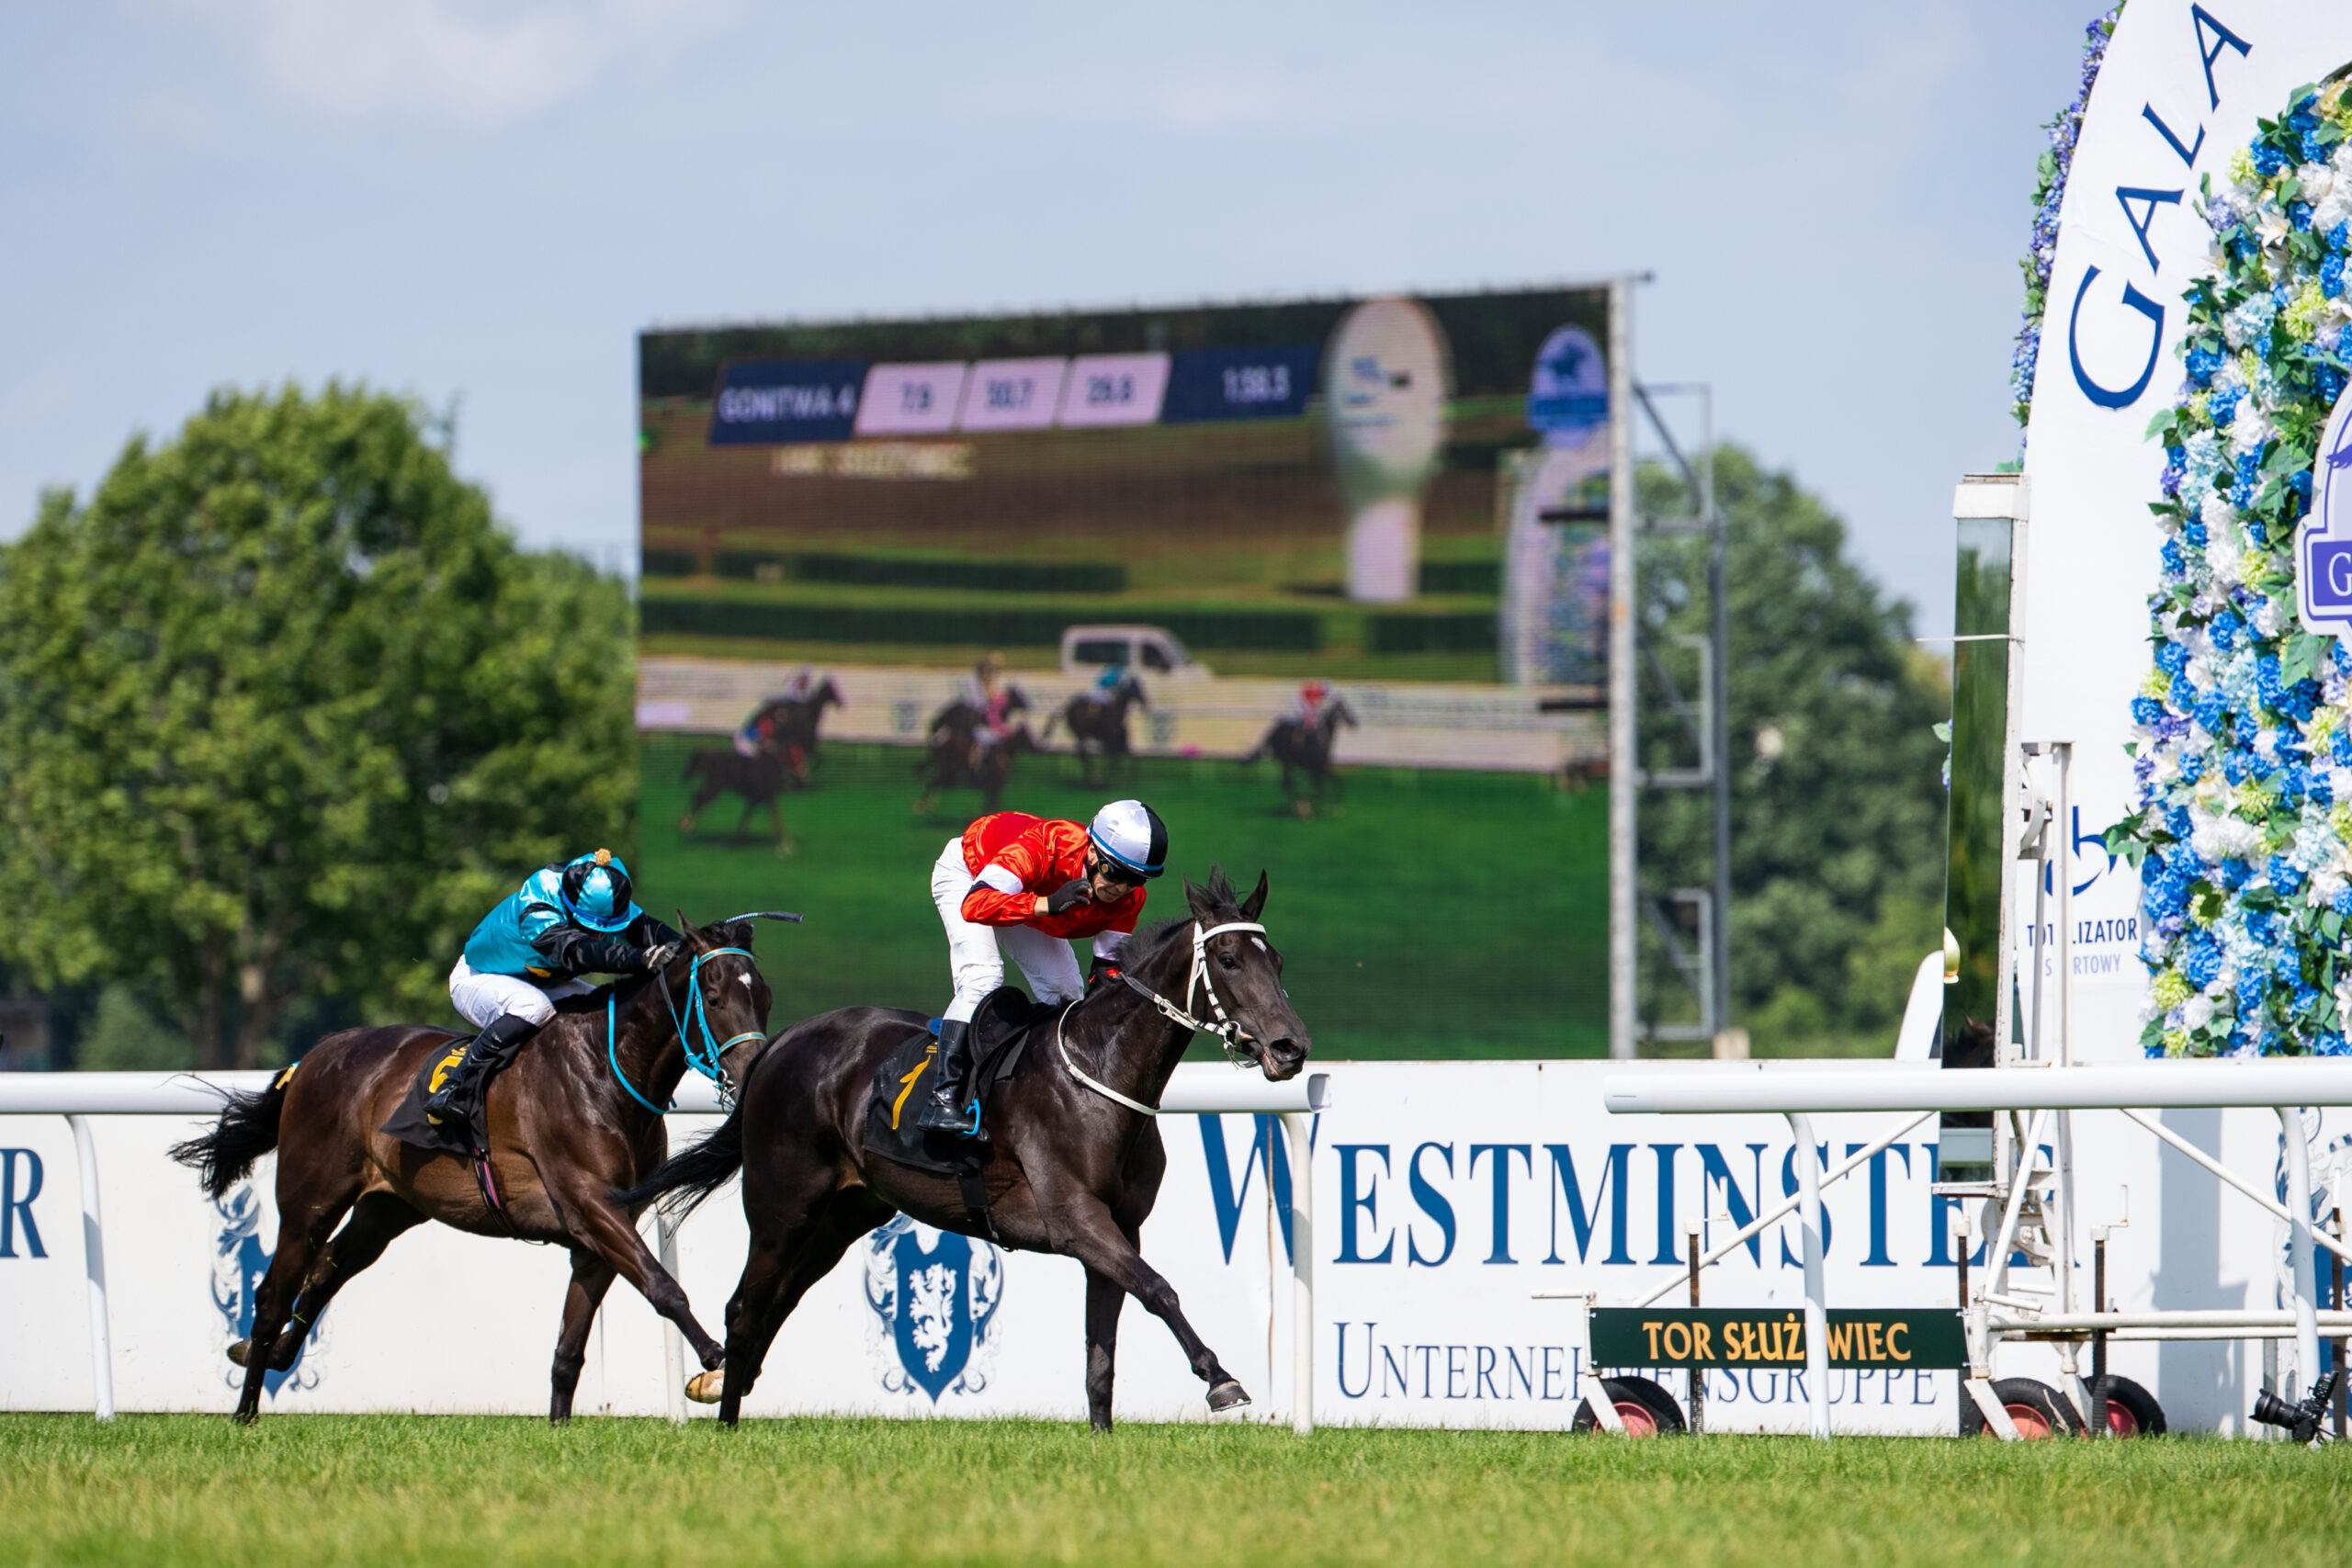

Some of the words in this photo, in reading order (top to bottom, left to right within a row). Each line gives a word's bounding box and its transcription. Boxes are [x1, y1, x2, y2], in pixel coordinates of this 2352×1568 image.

[2069, 2, 2254, 412] GALA
[719, 386, 833, 423] GONITWA
[2036, 954, 2121, 976] SRTOWY
[1642, 1322, 1716, 1360] TOR
[1724, 1313, 1912, 1361] SŁUŻWIEC
